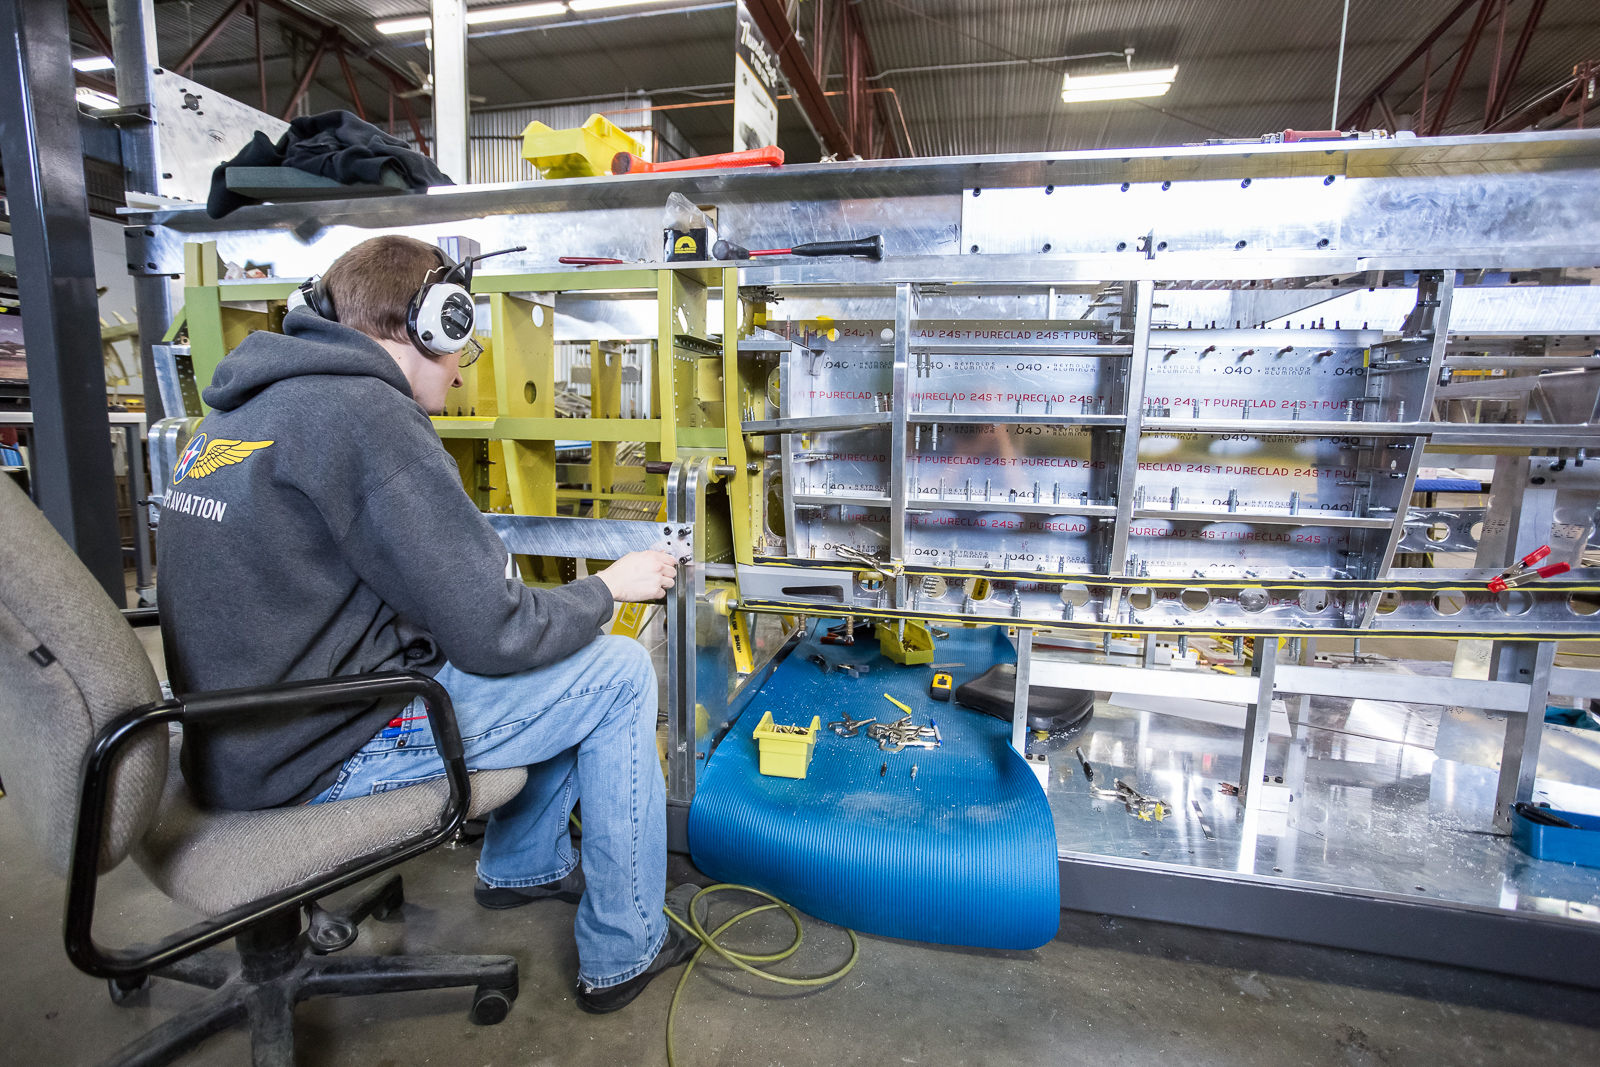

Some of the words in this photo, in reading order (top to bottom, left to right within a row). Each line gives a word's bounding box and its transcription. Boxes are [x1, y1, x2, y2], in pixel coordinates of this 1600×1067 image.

[938, 330, 972, 338] 24S-T
[974, 331, 1031, 340] PURECLAD
[1036, 332, 1070, 340] 24S-T
[1014, 362, 1042, 372] .040
[1222, 366, 1252, 374] .040
[1333, 368, 1364, 376] .040
[820, 391, 872, 400] PURECLAD
[970, 393, 1004, 402] 24S-T
[1007, 394, 1064, 402] PURECLAD
[1282, 400, 1319, 409] 24S-T
[1220, 434, 1250, 442] .040
[1329, 436, 1360, 445] .040
[833, 453, 886, 462] PURECLAD
[926, 456, 980, 465] PURECLAD
[984, 458, 1017, 466] 24S-T
[1022, 458, 1078, 468] PURECLAD
[1187, 465, 1222, 474] 24S-T
[1226, 466, 1288, 476] PURECLAD
[1294, 468, 1331, 478] 24S-T
[170, 490, 227, 522] AVIATION
[992, 520, 1024, 528] 24S-T
[1030, 522, 1086, 532] PURECLAD
[1192, 530, 1227, 540] 24S-T
